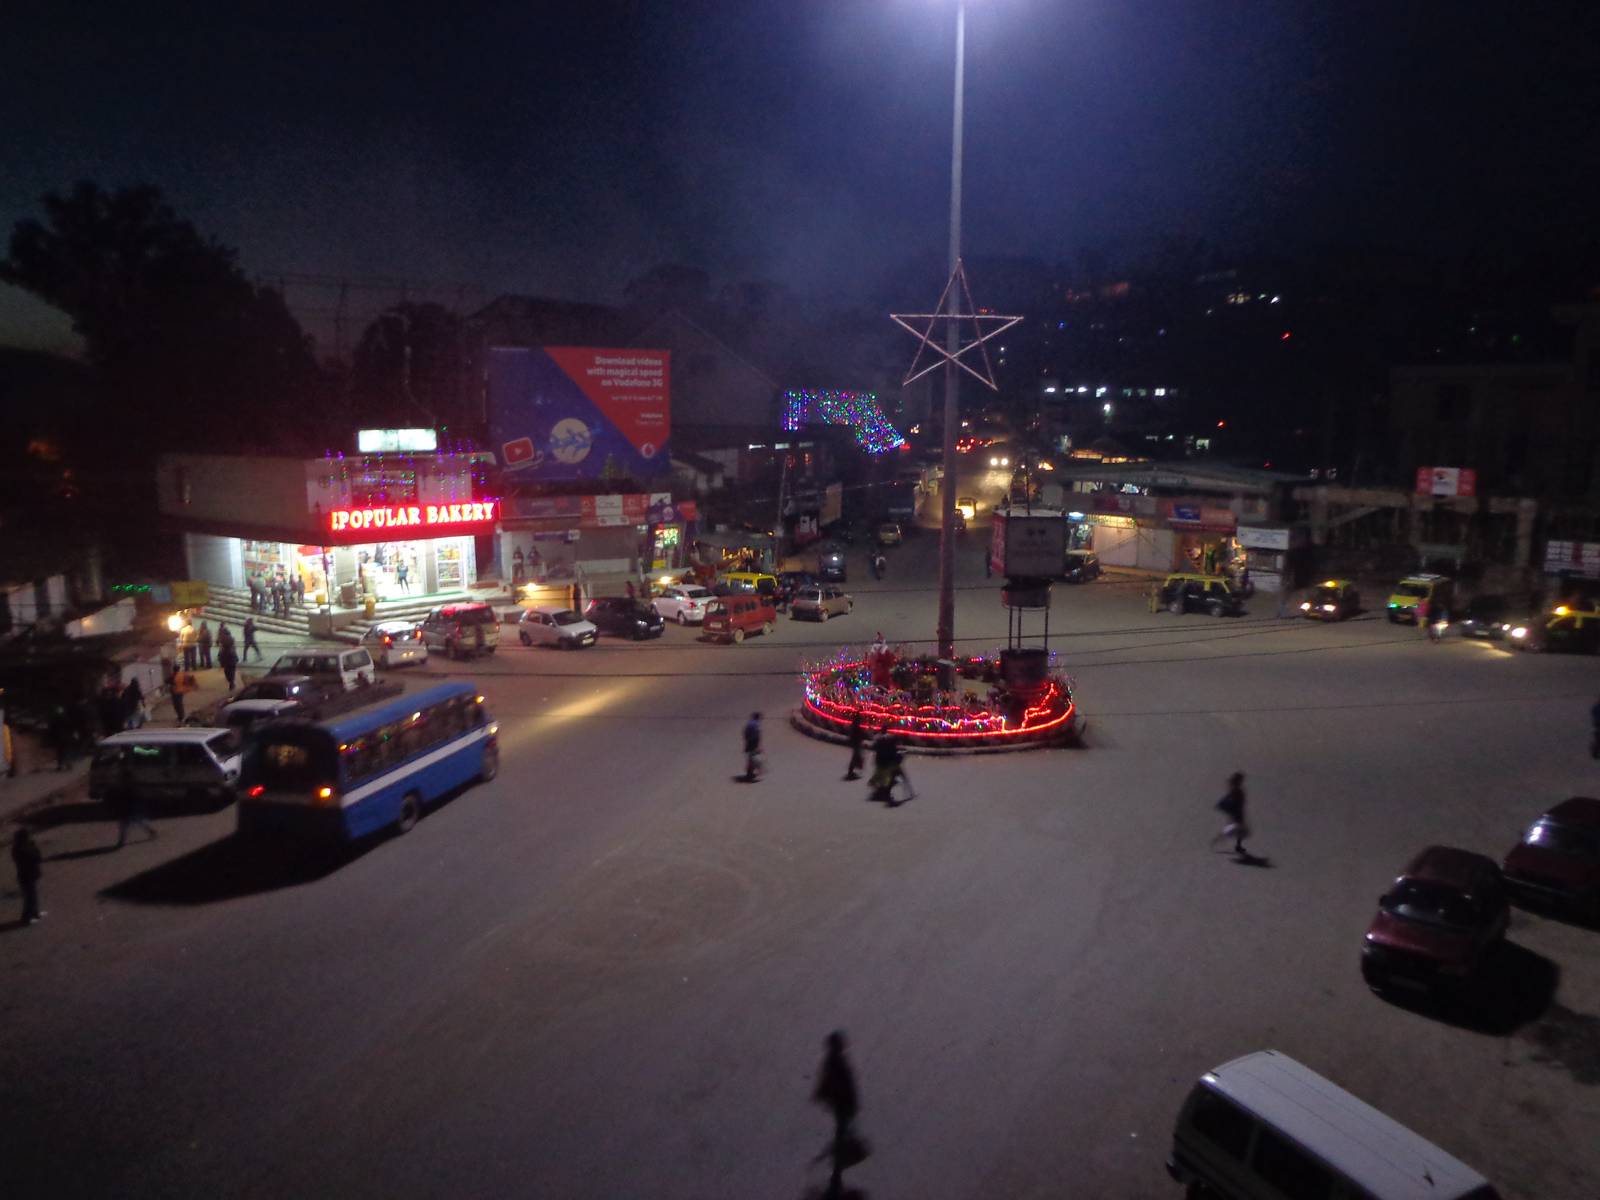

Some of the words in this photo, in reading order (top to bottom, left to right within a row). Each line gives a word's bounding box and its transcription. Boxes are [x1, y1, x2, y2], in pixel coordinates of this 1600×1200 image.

[596, 356, 636, 365] Download
[586, 367, 606, 376] with
[607, 367, 638, 378] magical
[639, 368, 663, 378] speed
[613, 378, 651, 387] Vodafone
[426, 502, 495, 524] BAKERY
